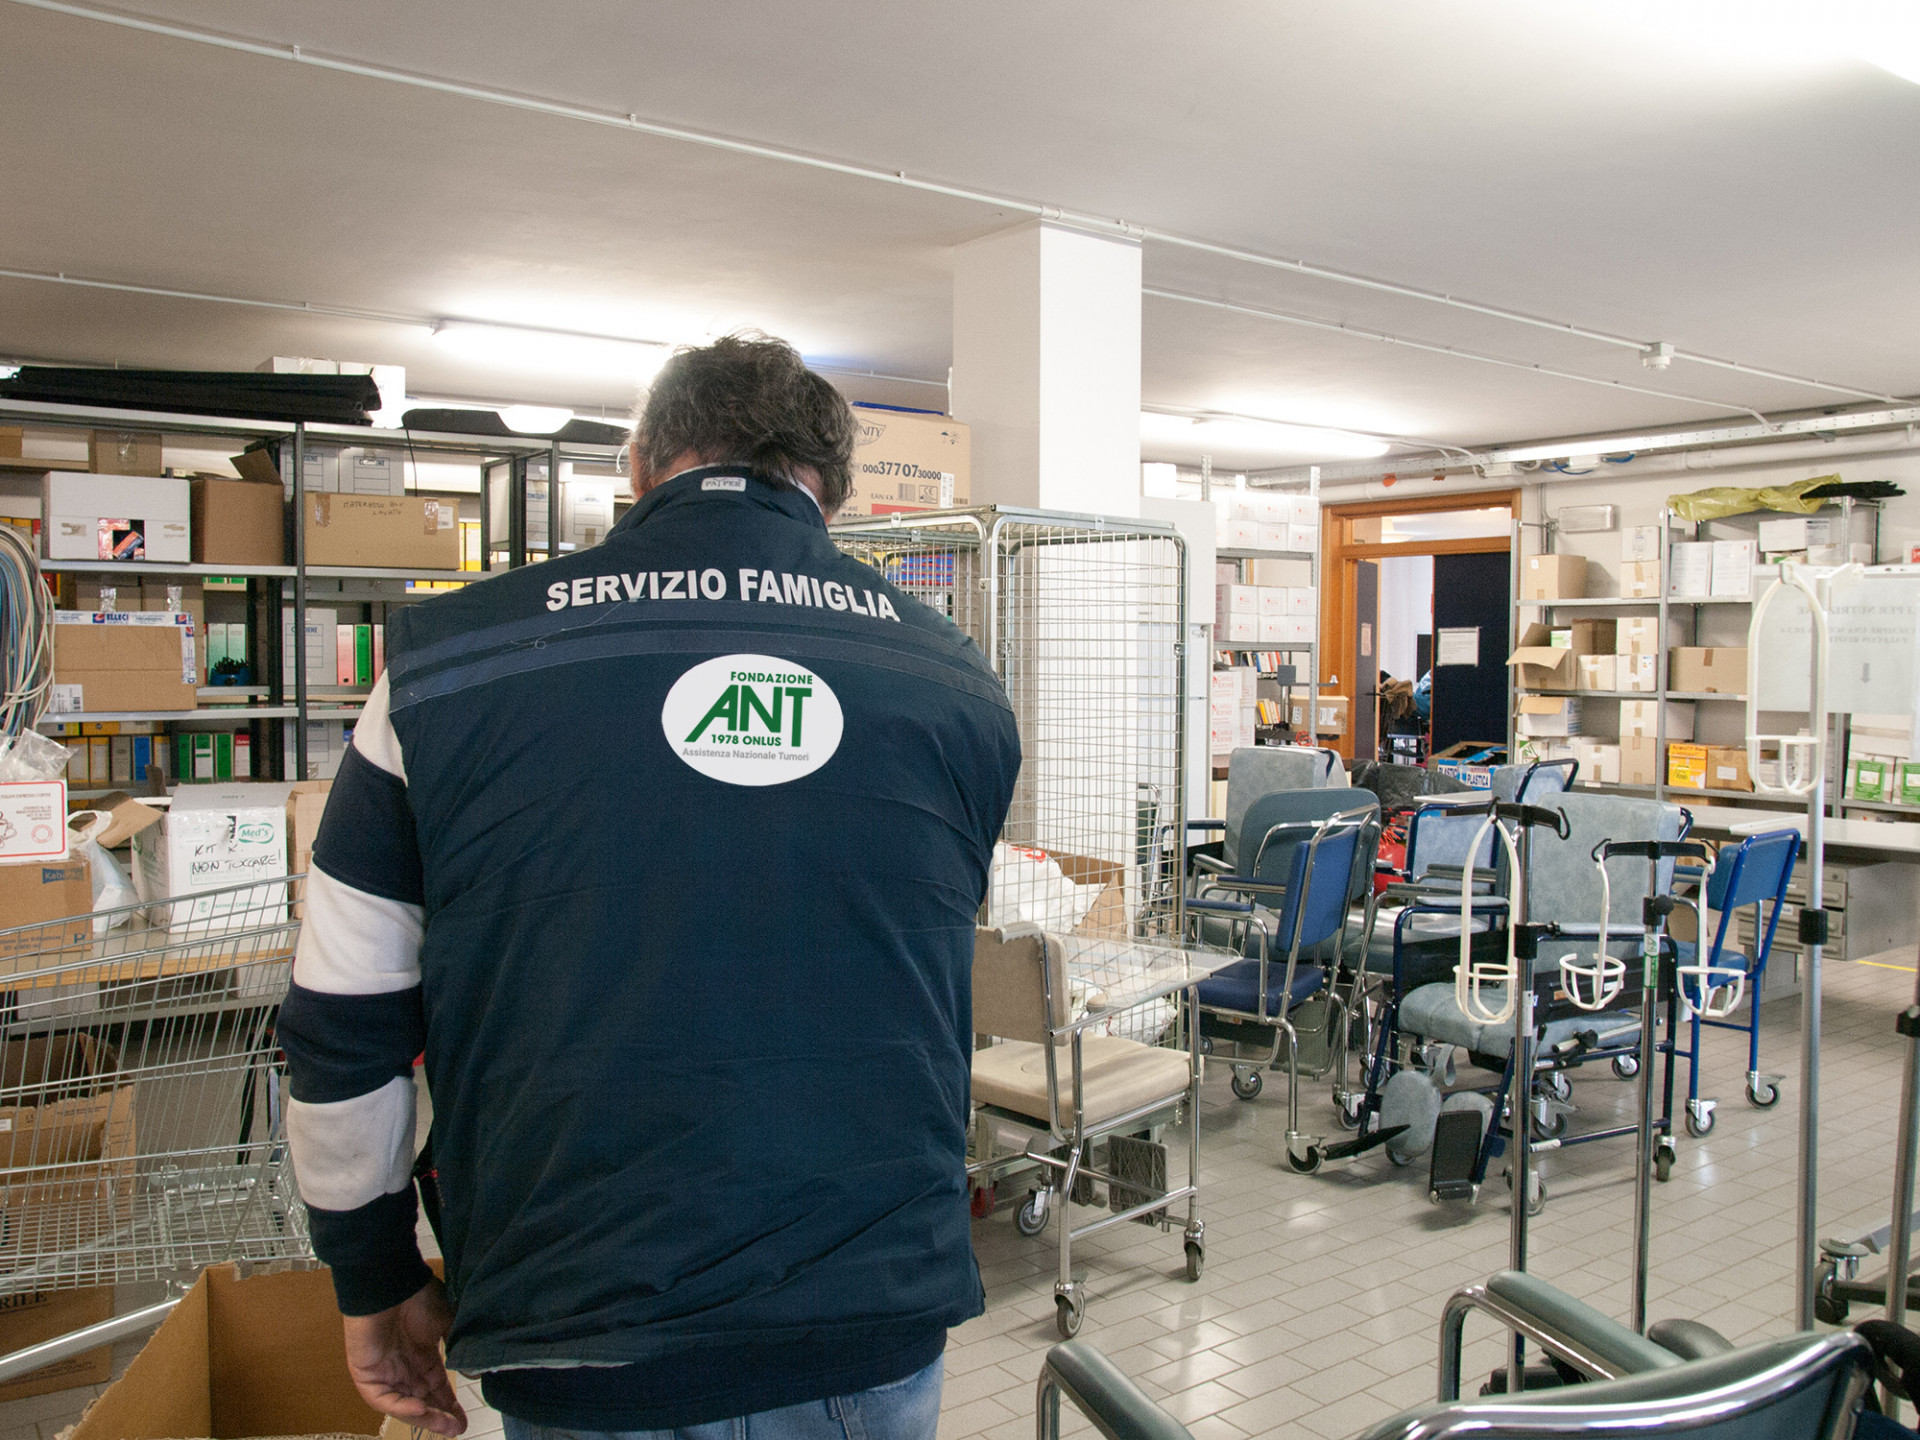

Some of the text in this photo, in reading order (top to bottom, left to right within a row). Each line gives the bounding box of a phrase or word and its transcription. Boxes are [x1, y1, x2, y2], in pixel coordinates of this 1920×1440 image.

[546, 568, 901, 622] SERVIZIO FAMIGLIA
[730, 671, 813, 685] FONDAZIONE
[684, 684, 812, 748] ANT
[711, 734, 782, 746] 1978 ONLUS
[682, 748, 809, 761] Assistenza Nazionale Tumori
[1467, 774, 1489, 786] PLASTICA
[241, 828, 269, 837] Med's
[194, 844, 217, 857] KIT
[191, 861, 220, 875] NON
